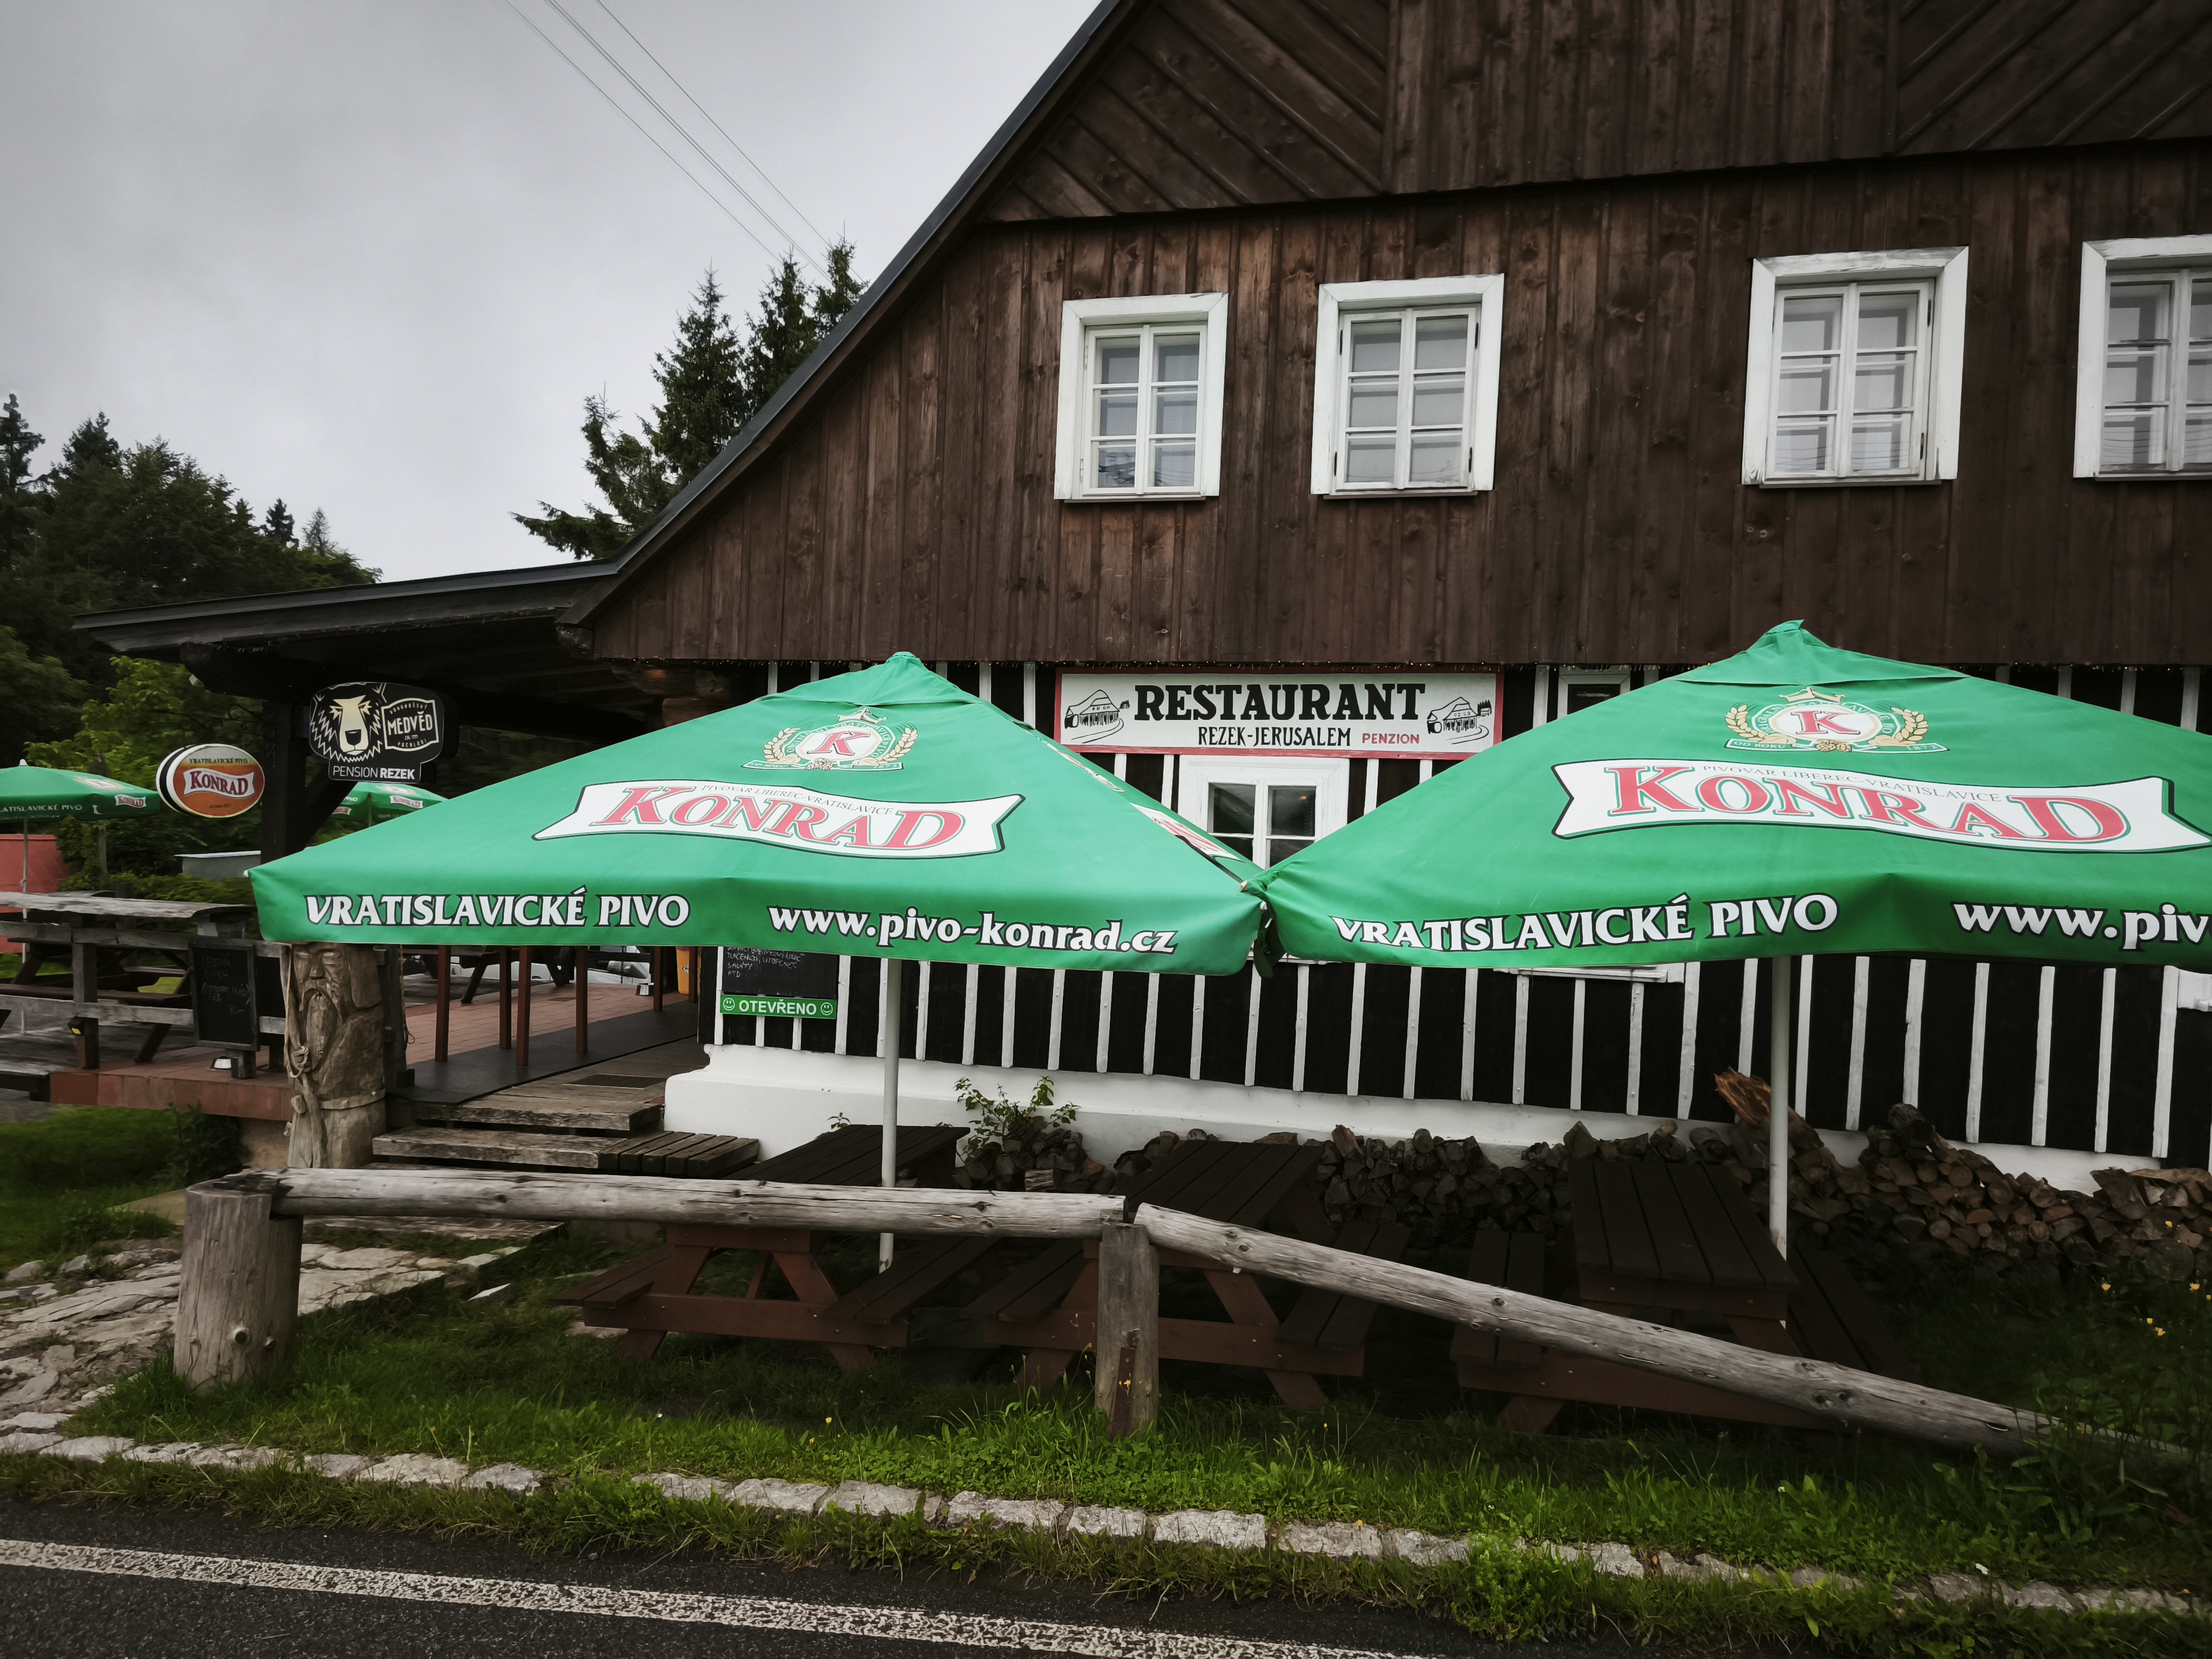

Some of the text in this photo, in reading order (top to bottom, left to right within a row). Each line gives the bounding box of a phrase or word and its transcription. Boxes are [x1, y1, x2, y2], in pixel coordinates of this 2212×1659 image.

[1135, 683, 1426, 721] RESTAURANT
[387, 711, 433, 736] MEDVĚD
[1791, 710, 1860, 735] K
[806, 730, 871, 756] K
[1198, 726, 1420, 747] REZEK-JERUSALEM PENZION
[190, 770, 248, 795] KONRAD
[333, 766, 415, 780] PENSION REZEK
[1703, 765, 1776, 777] PIVOVAR
[702, 785, 753, 794] PIVOVAR
[1603, 765, 2131, 845] KONRAD
[588, 785, 966, 851] KONRAD
[306, 885, 691, 927] VRATISLAVICKÉ PIVO
[768, 906, 1180, 955] www.pivo-konrad.cz
[1330, 892, 1839, 952] VRATISLAVICKÉ PIVO
[1951, 902, 2212, 952] www.piv
[738, 999, 817, 1015] OTEVŘENO
